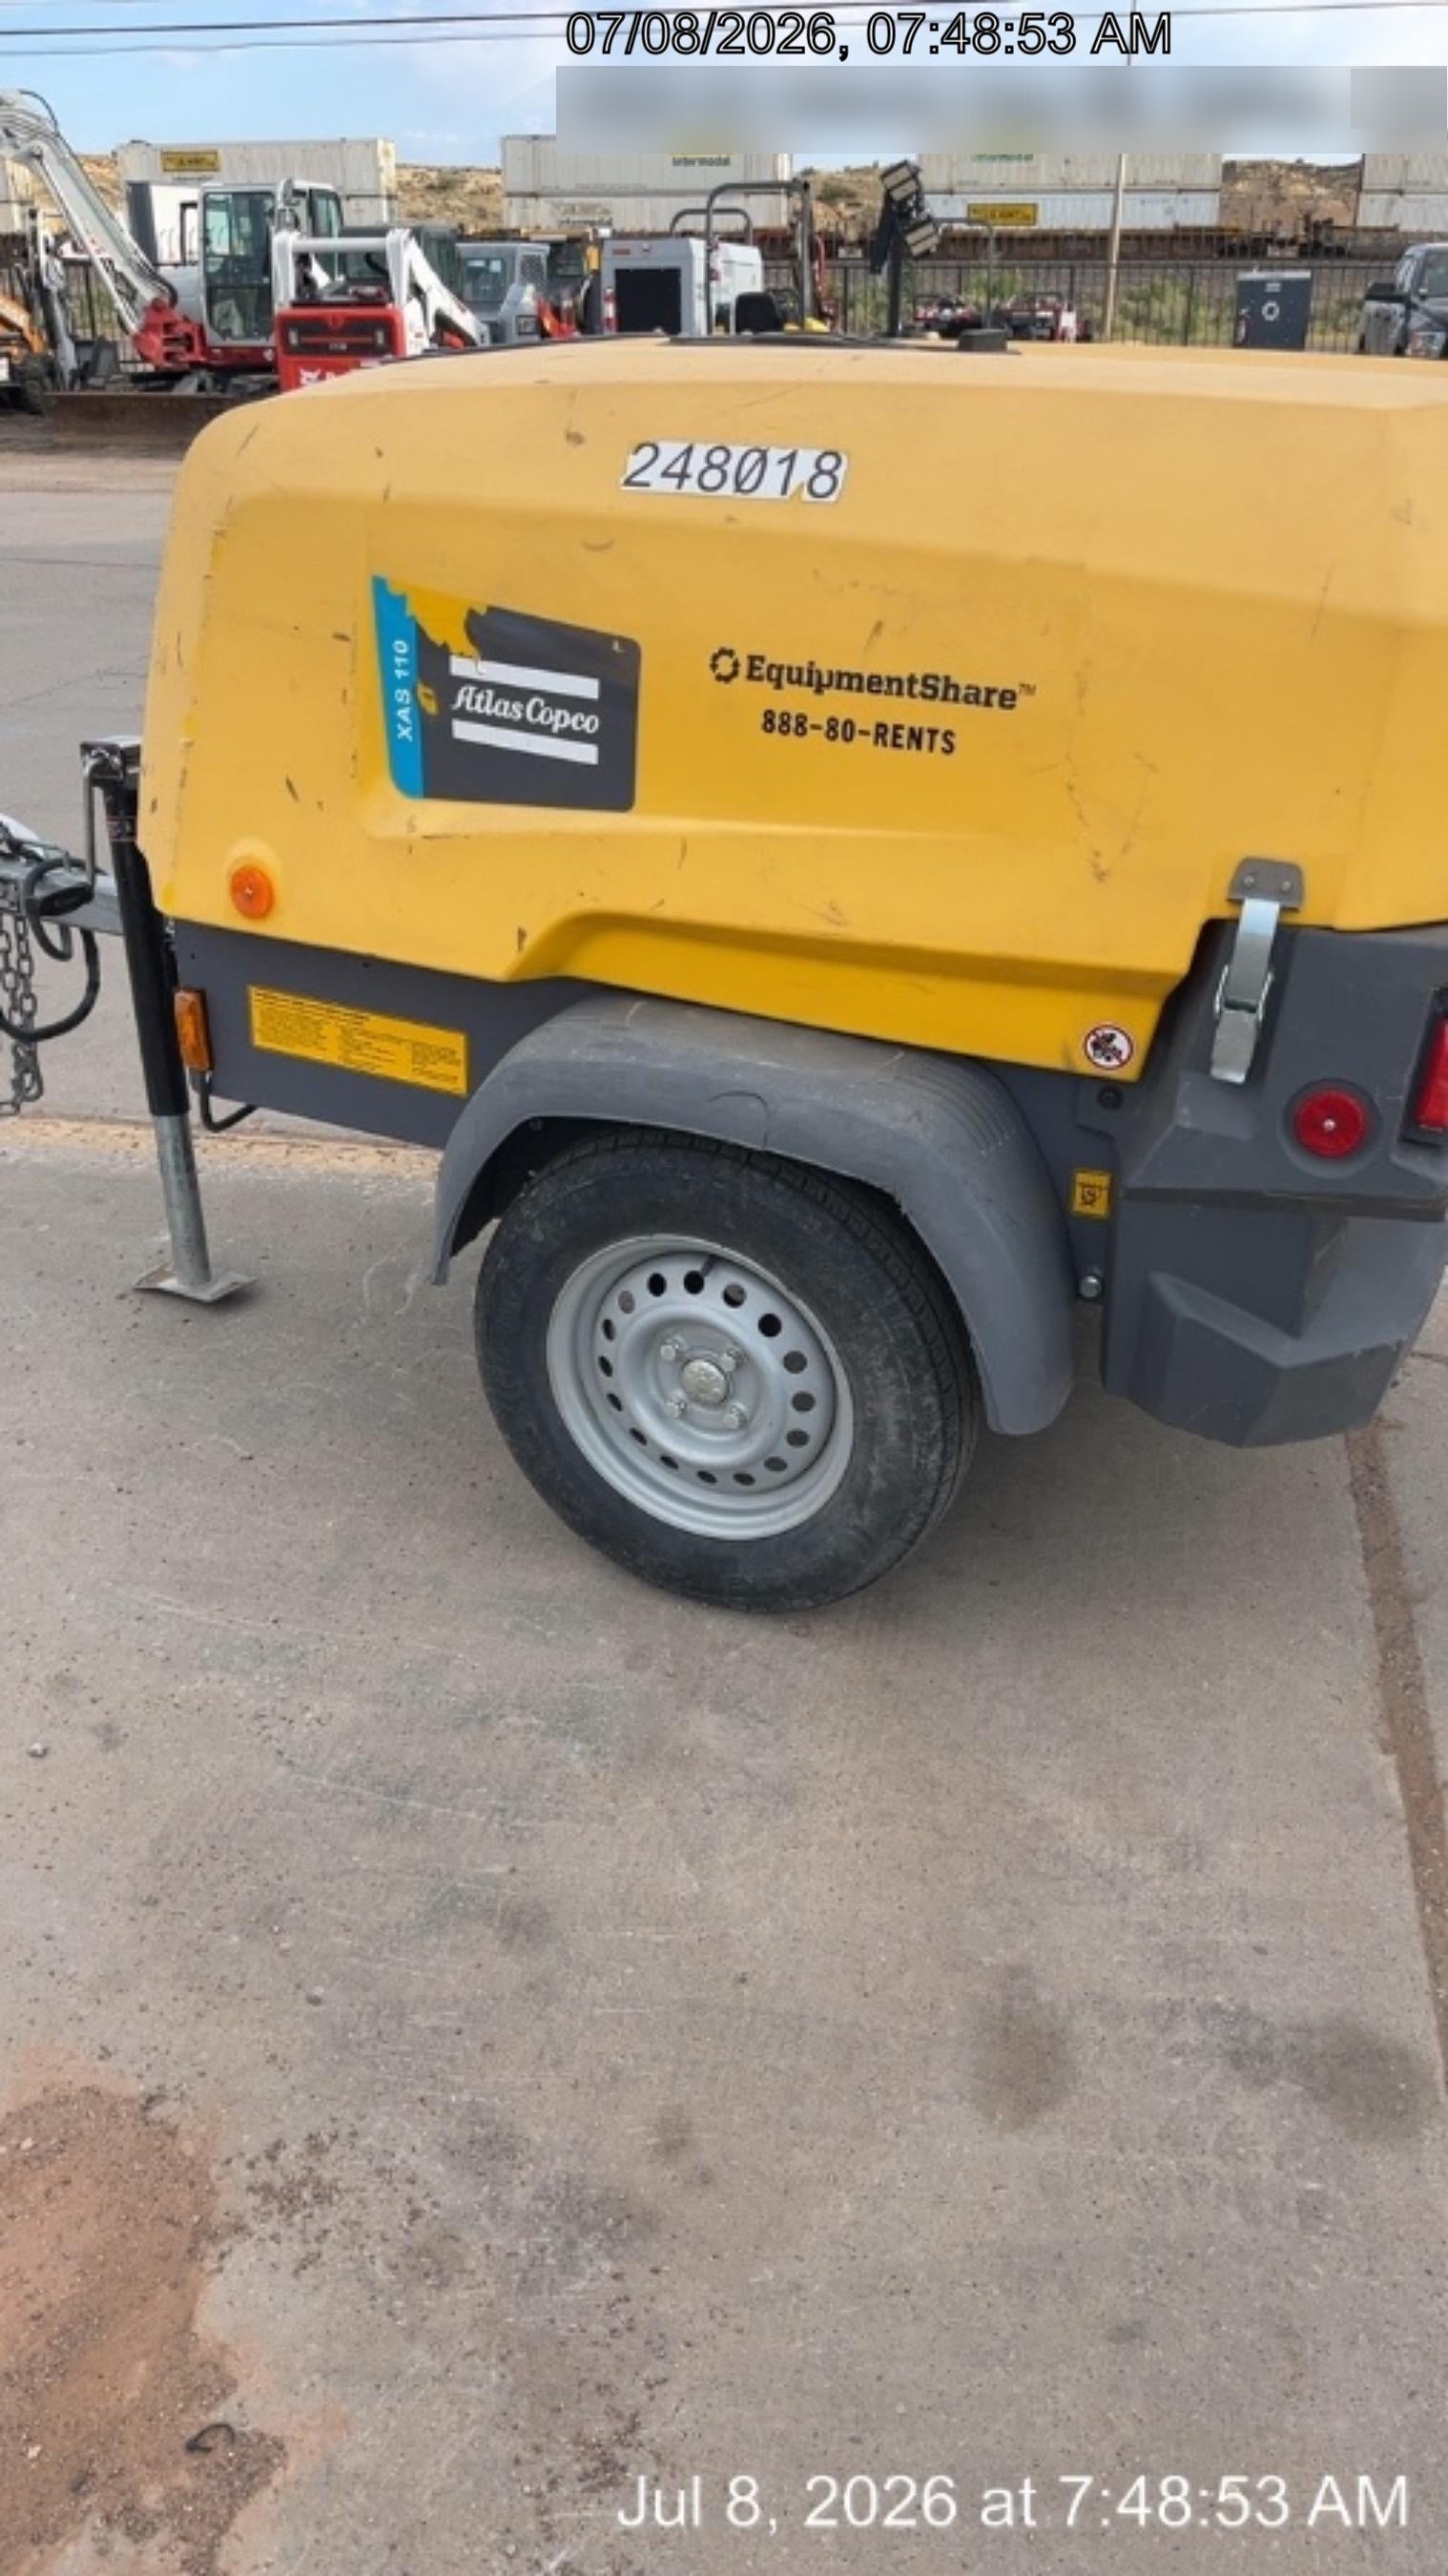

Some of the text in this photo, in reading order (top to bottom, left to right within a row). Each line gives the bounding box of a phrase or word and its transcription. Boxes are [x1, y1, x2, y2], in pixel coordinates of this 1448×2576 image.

[623, 442, 842, 499] 248018
[392, 640, 413, 741] XAS 110
[451, 685, 598, 734] Atlas Copco
[760, 710, 957, 755] 888-80-RENTS
